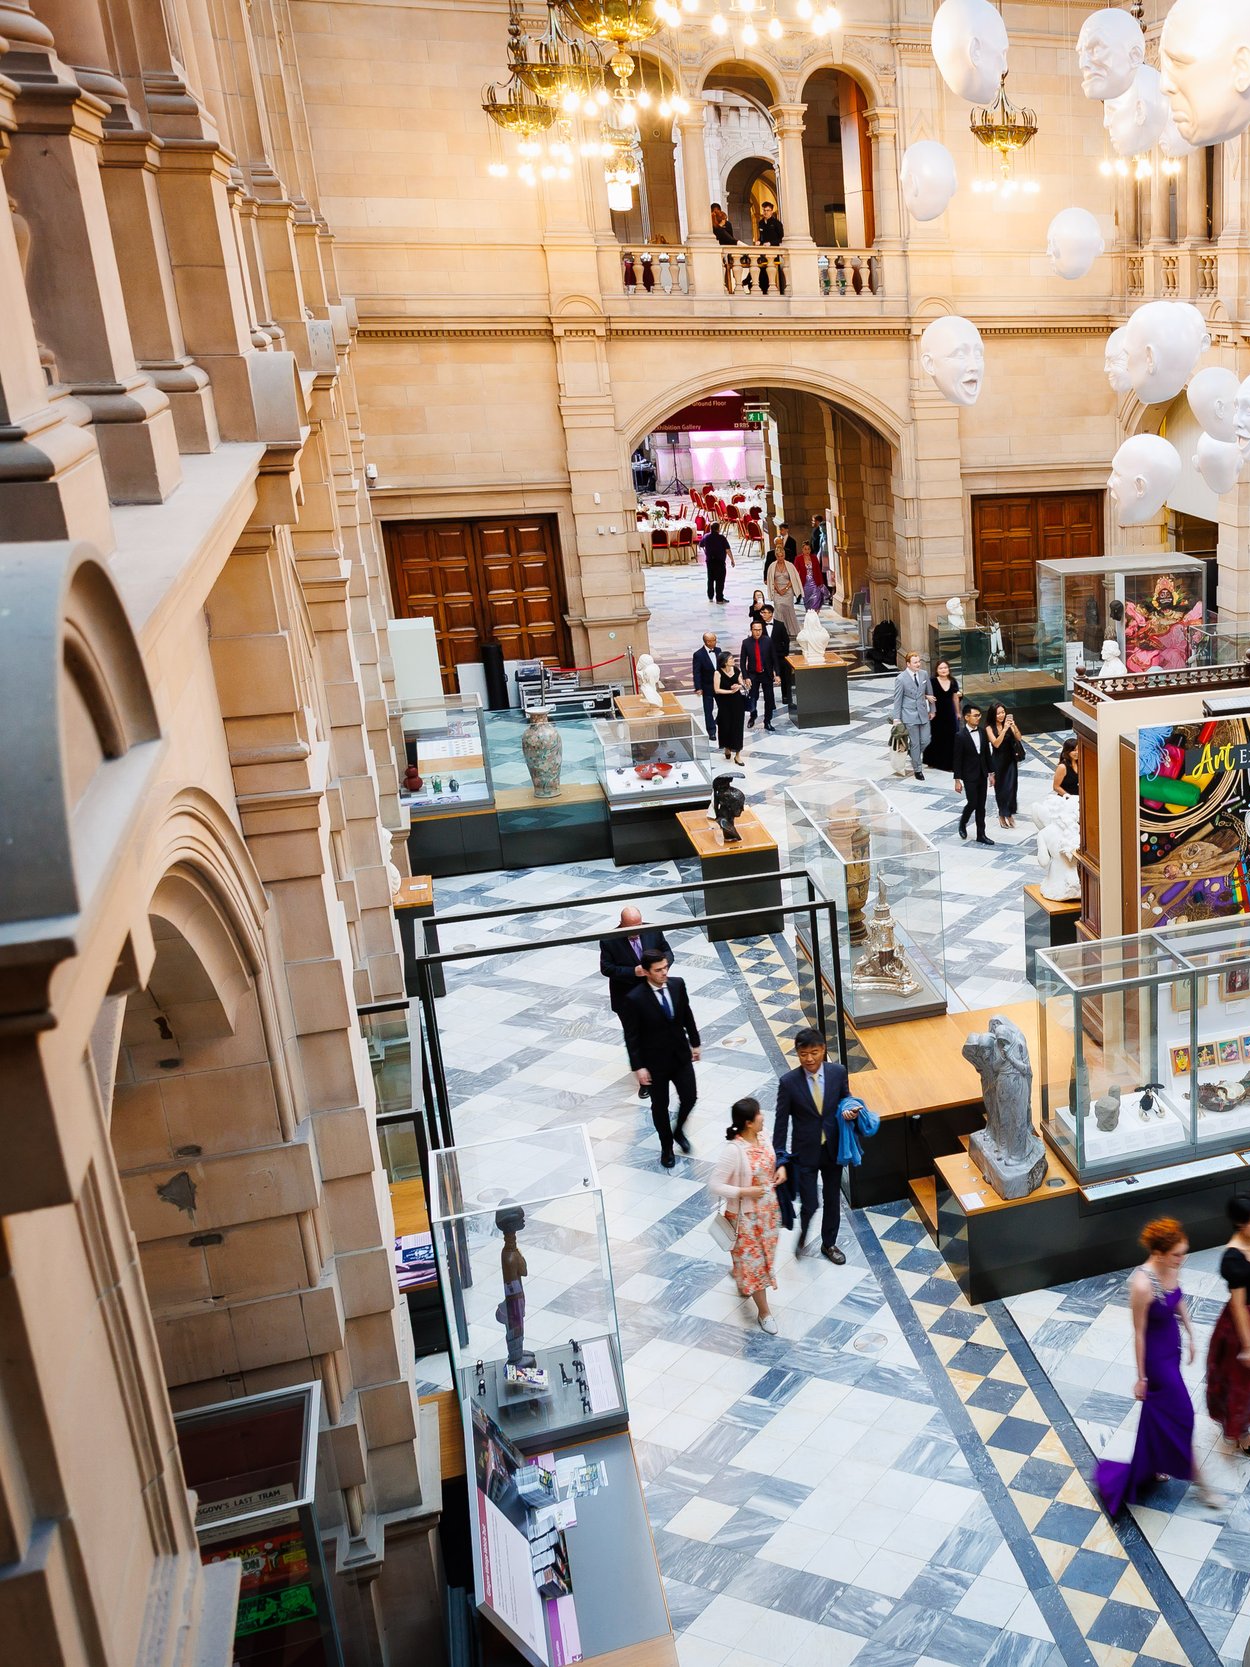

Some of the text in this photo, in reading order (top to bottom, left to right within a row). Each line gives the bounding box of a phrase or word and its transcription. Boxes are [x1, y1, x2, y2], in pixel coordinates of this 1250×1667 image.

[1192, 742, 1235, 779] Art
[198, 1489, 281, 1516] SGOW'S LAST TRAM
